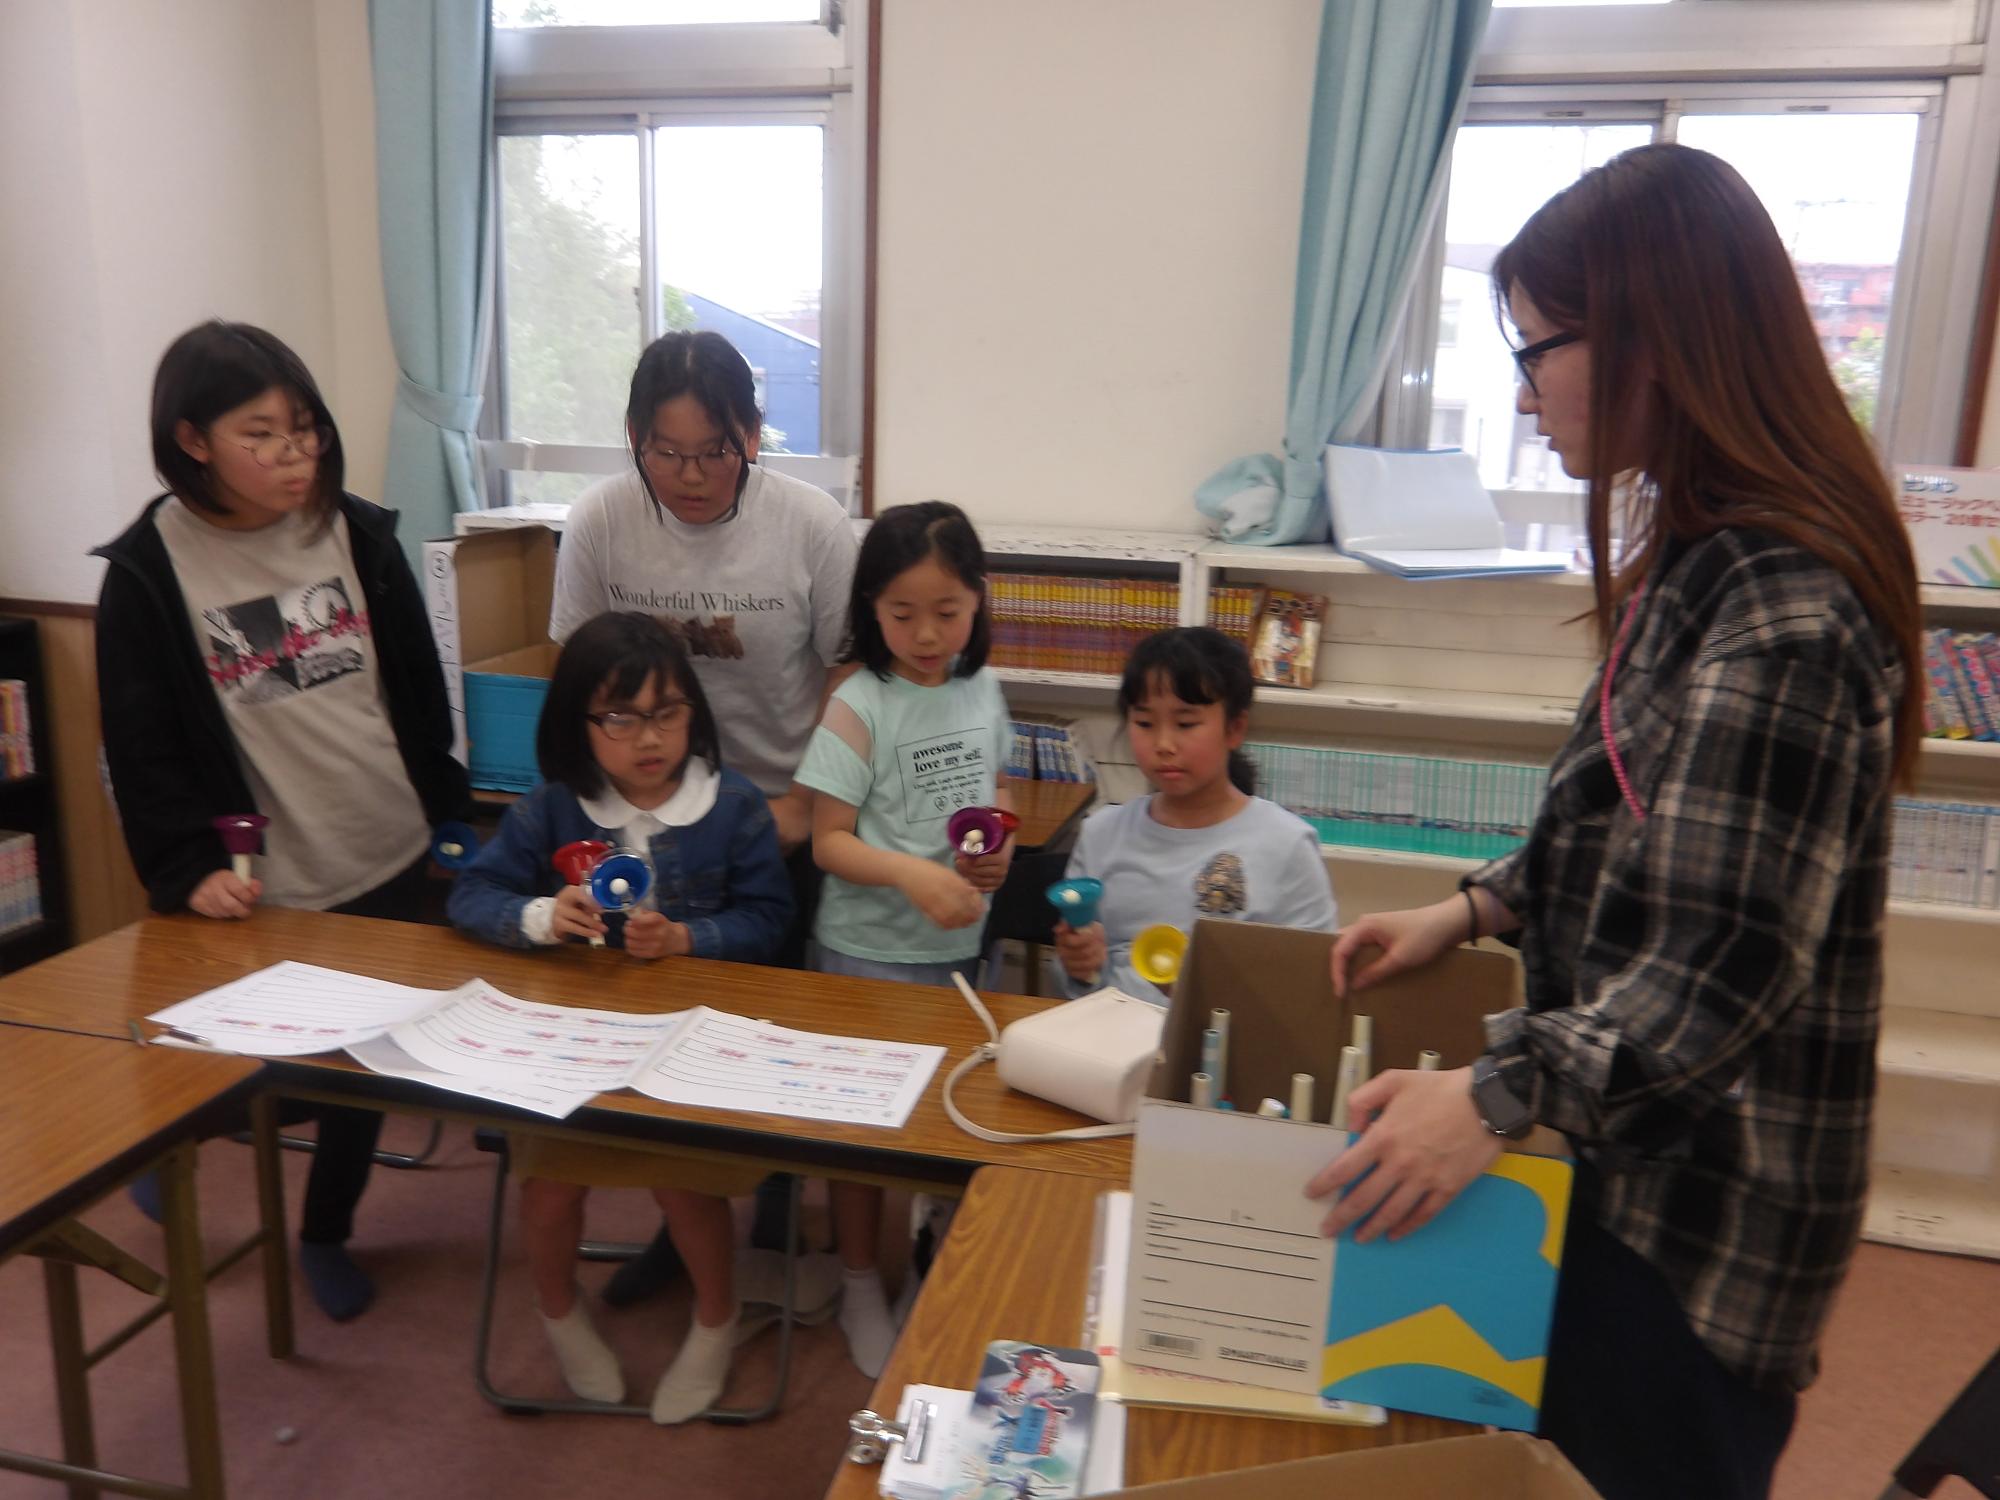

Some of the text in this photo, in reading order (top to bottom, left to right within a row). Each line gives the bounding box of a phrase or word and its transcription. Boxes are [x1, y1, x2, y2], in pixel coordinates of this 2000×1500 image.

[608, 583, 785, 612] Wonderful Whiskers
[912, 741, 964, 760] awesome
[914, 760, 941, 773] love
[944, 757, 960, 768] my
